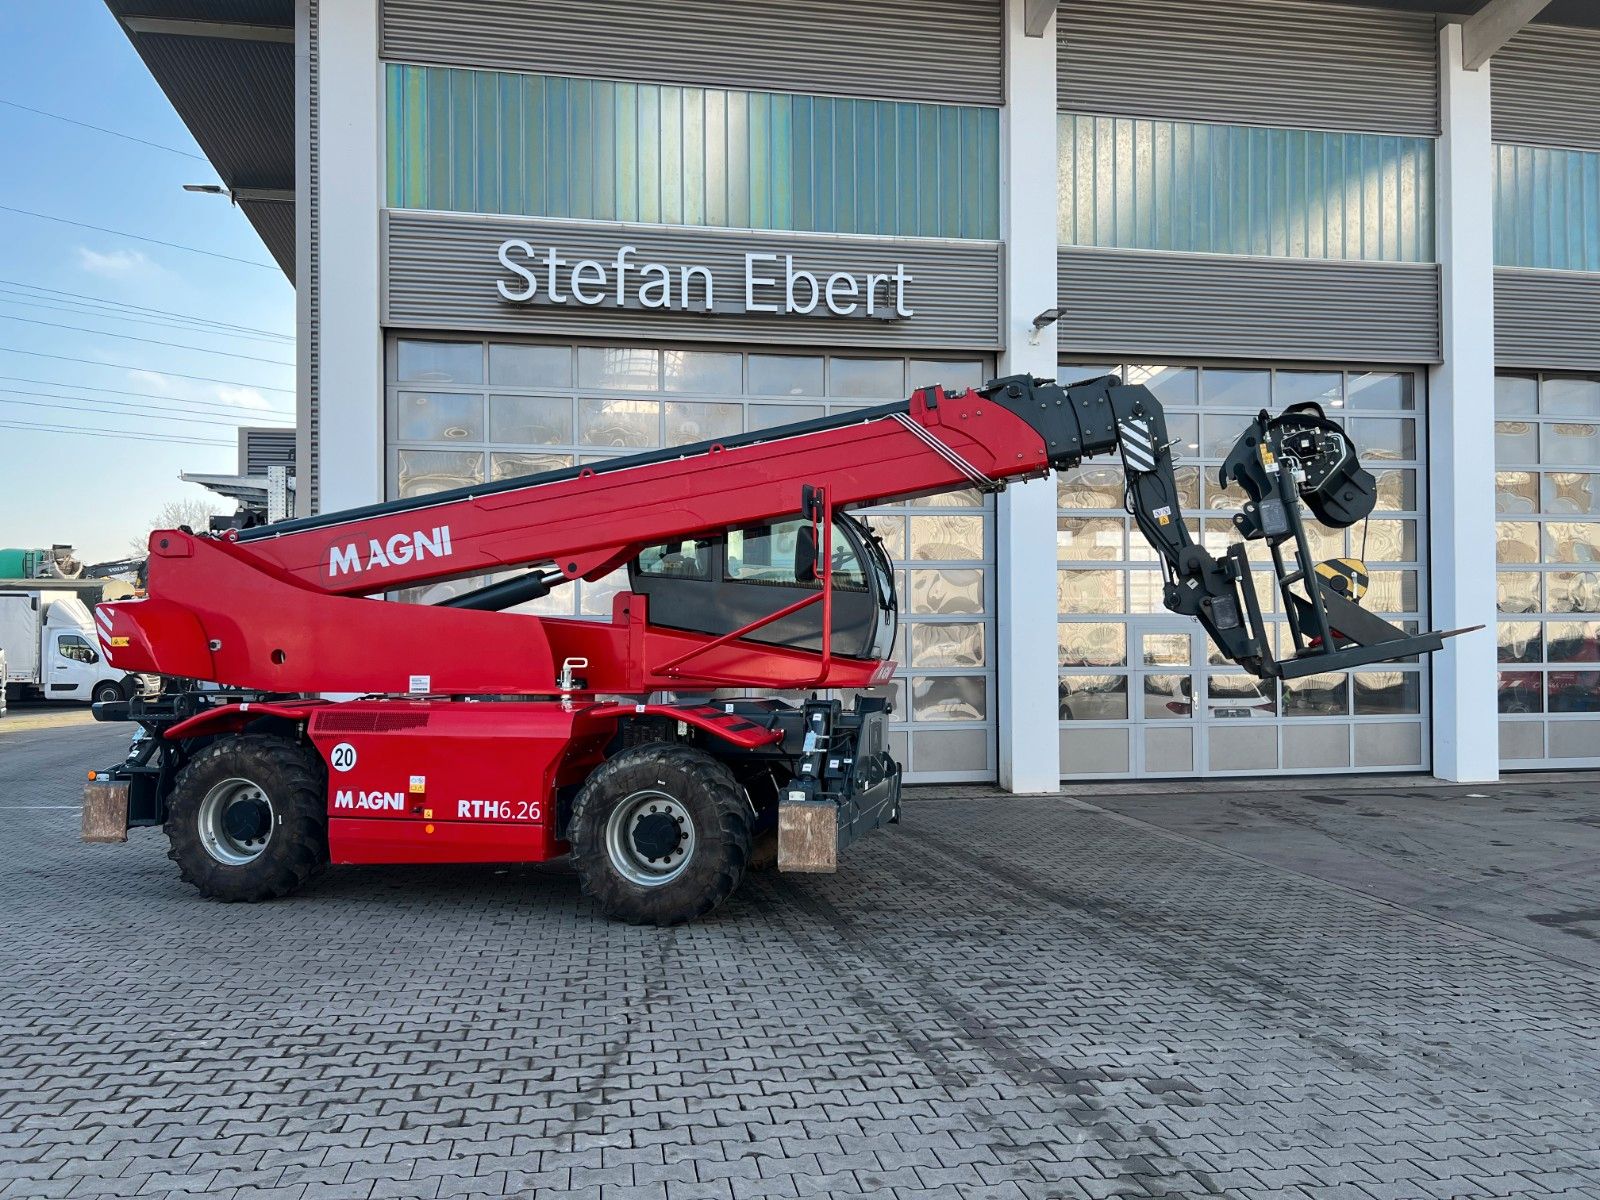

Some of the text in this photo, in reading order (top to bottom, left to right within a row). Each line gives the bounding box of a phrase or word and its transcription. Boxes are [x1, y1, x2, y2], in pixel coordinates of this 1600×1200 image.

[496, 239, 914, 317] Stefan Ebert
[329, 525, 452, 576] MAGNI
[334, 747, 354, 767] 20
[334, 790, 405, 811] MAGNI
[457, 799, 541, 820] RTH6.26
